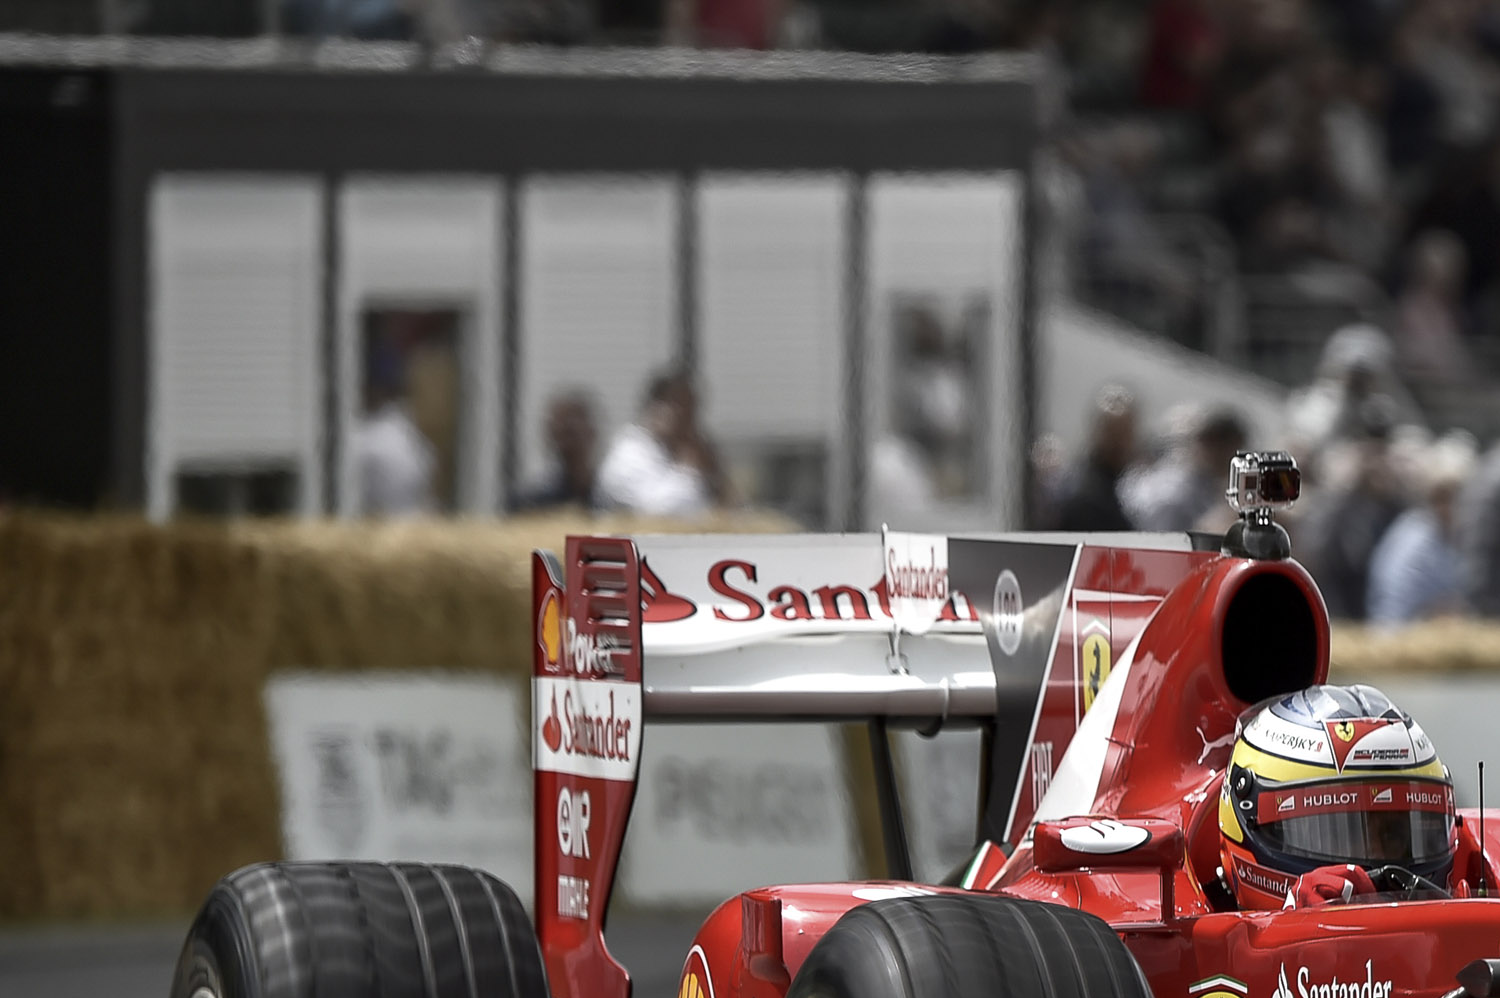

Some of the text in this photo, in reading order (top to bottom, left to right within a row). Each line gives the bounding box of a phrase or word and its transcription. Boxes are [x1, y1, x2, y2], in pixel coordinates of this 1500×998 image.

[565, 690, 631, 761] Santander
[1303, 793, 1358, 808] HUBLOT
[1406, 792, 1442, 805] HUBLOT
